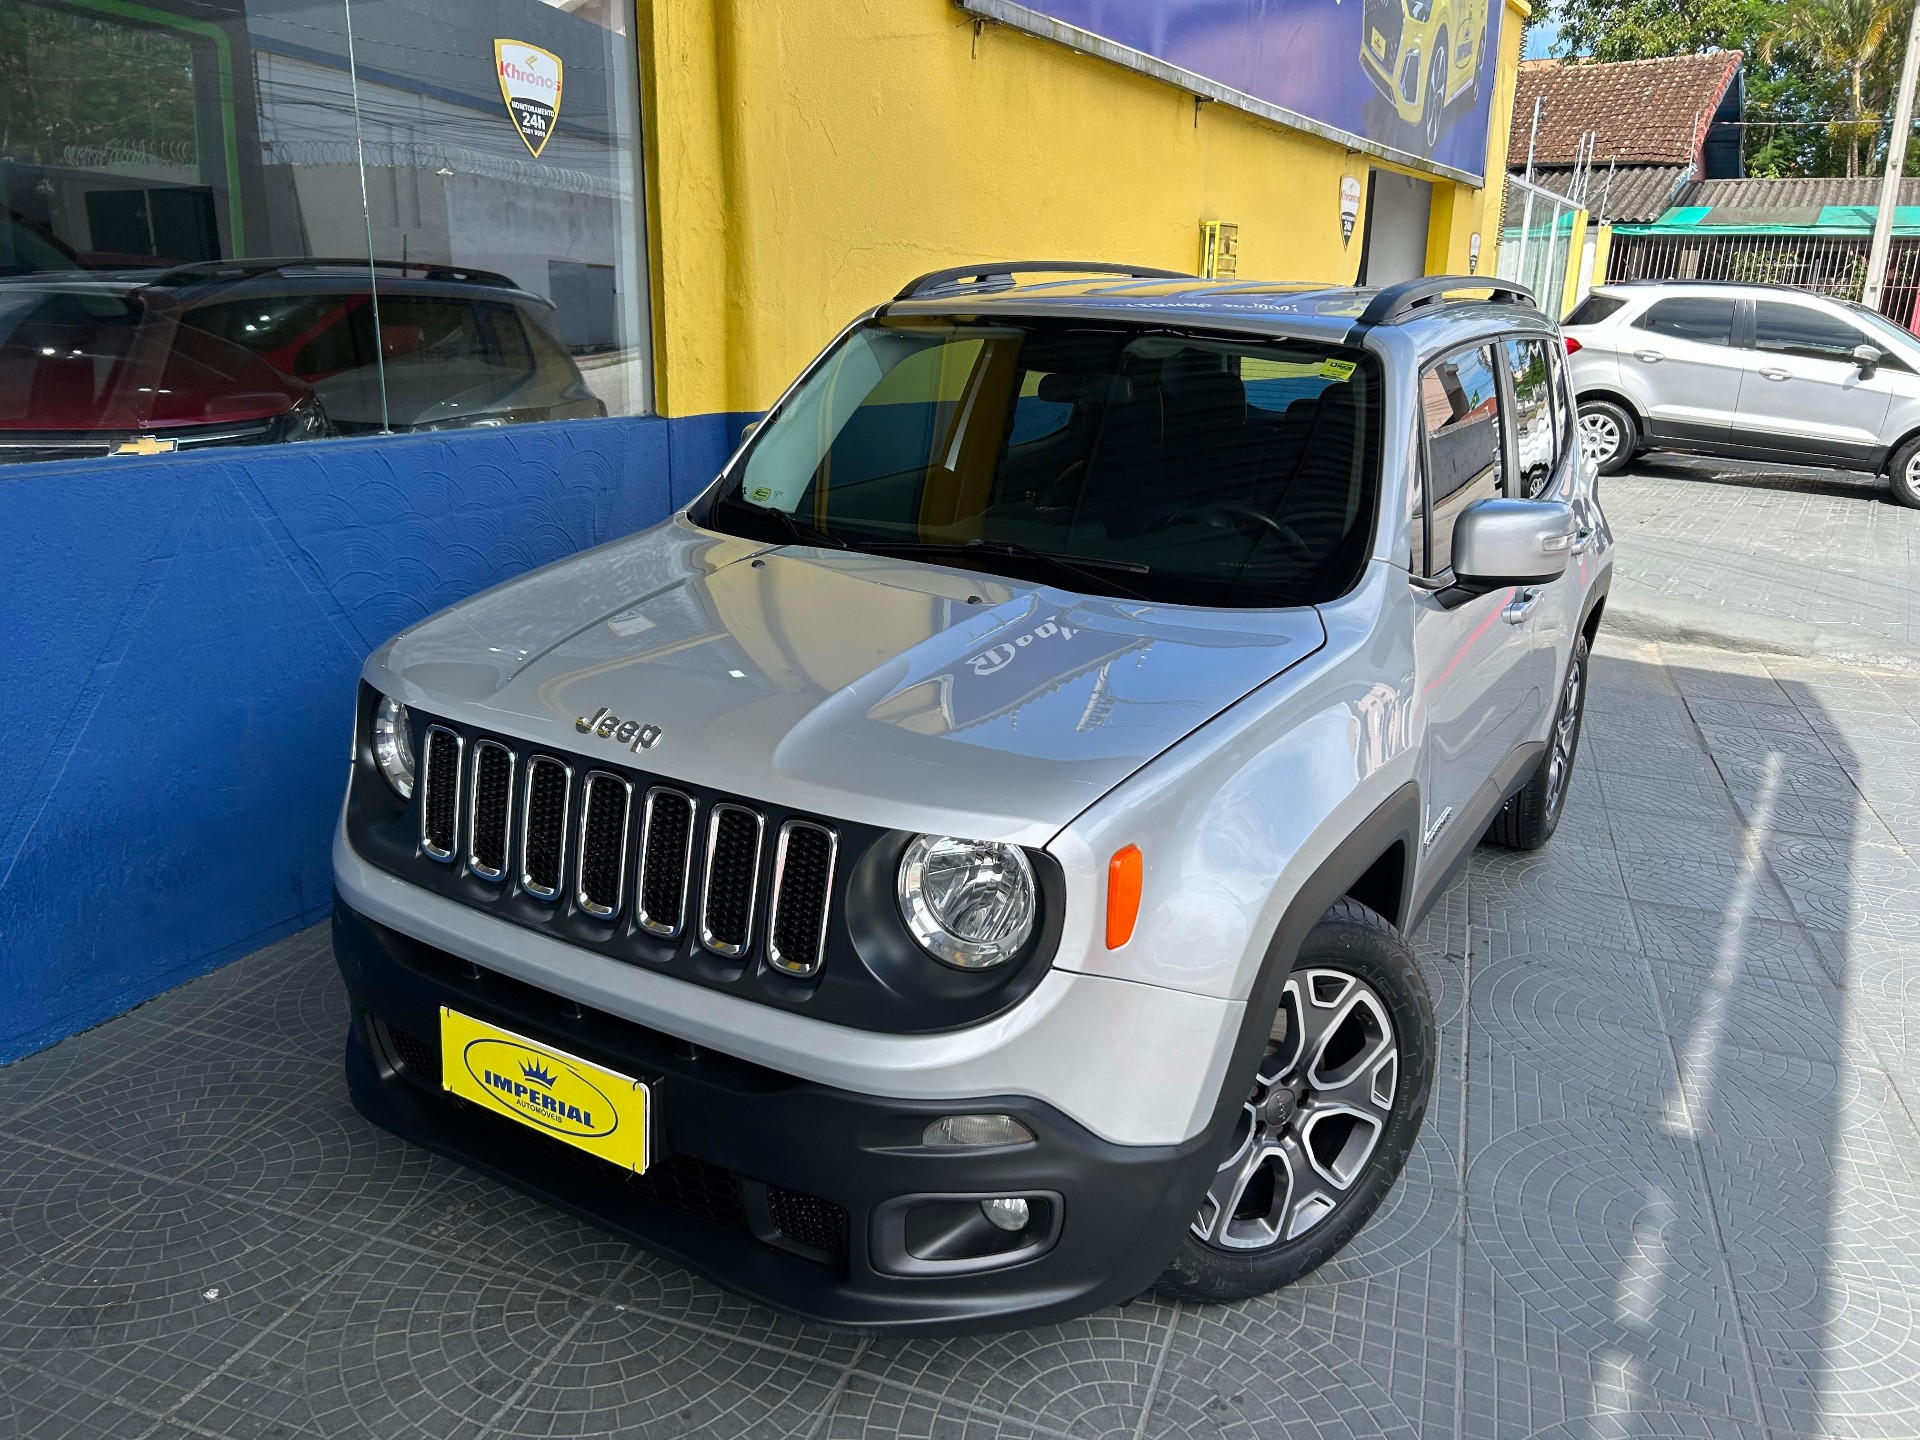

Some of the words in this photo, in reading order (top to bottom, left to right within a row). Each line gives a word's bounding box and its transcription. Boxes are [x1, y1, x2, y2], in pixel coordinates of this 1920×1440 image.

[499, 60, 562, 92] Khronos
[511, 100, 555, 117] MONITORAMENTO
[522, 112, 546, 130] 24h
[575, 706, 664, 755] Jeep
[484, 1068, 595, 1129] IMPERIAL
[516, 1098, 563, 1124] AUTOMÓVEIS
